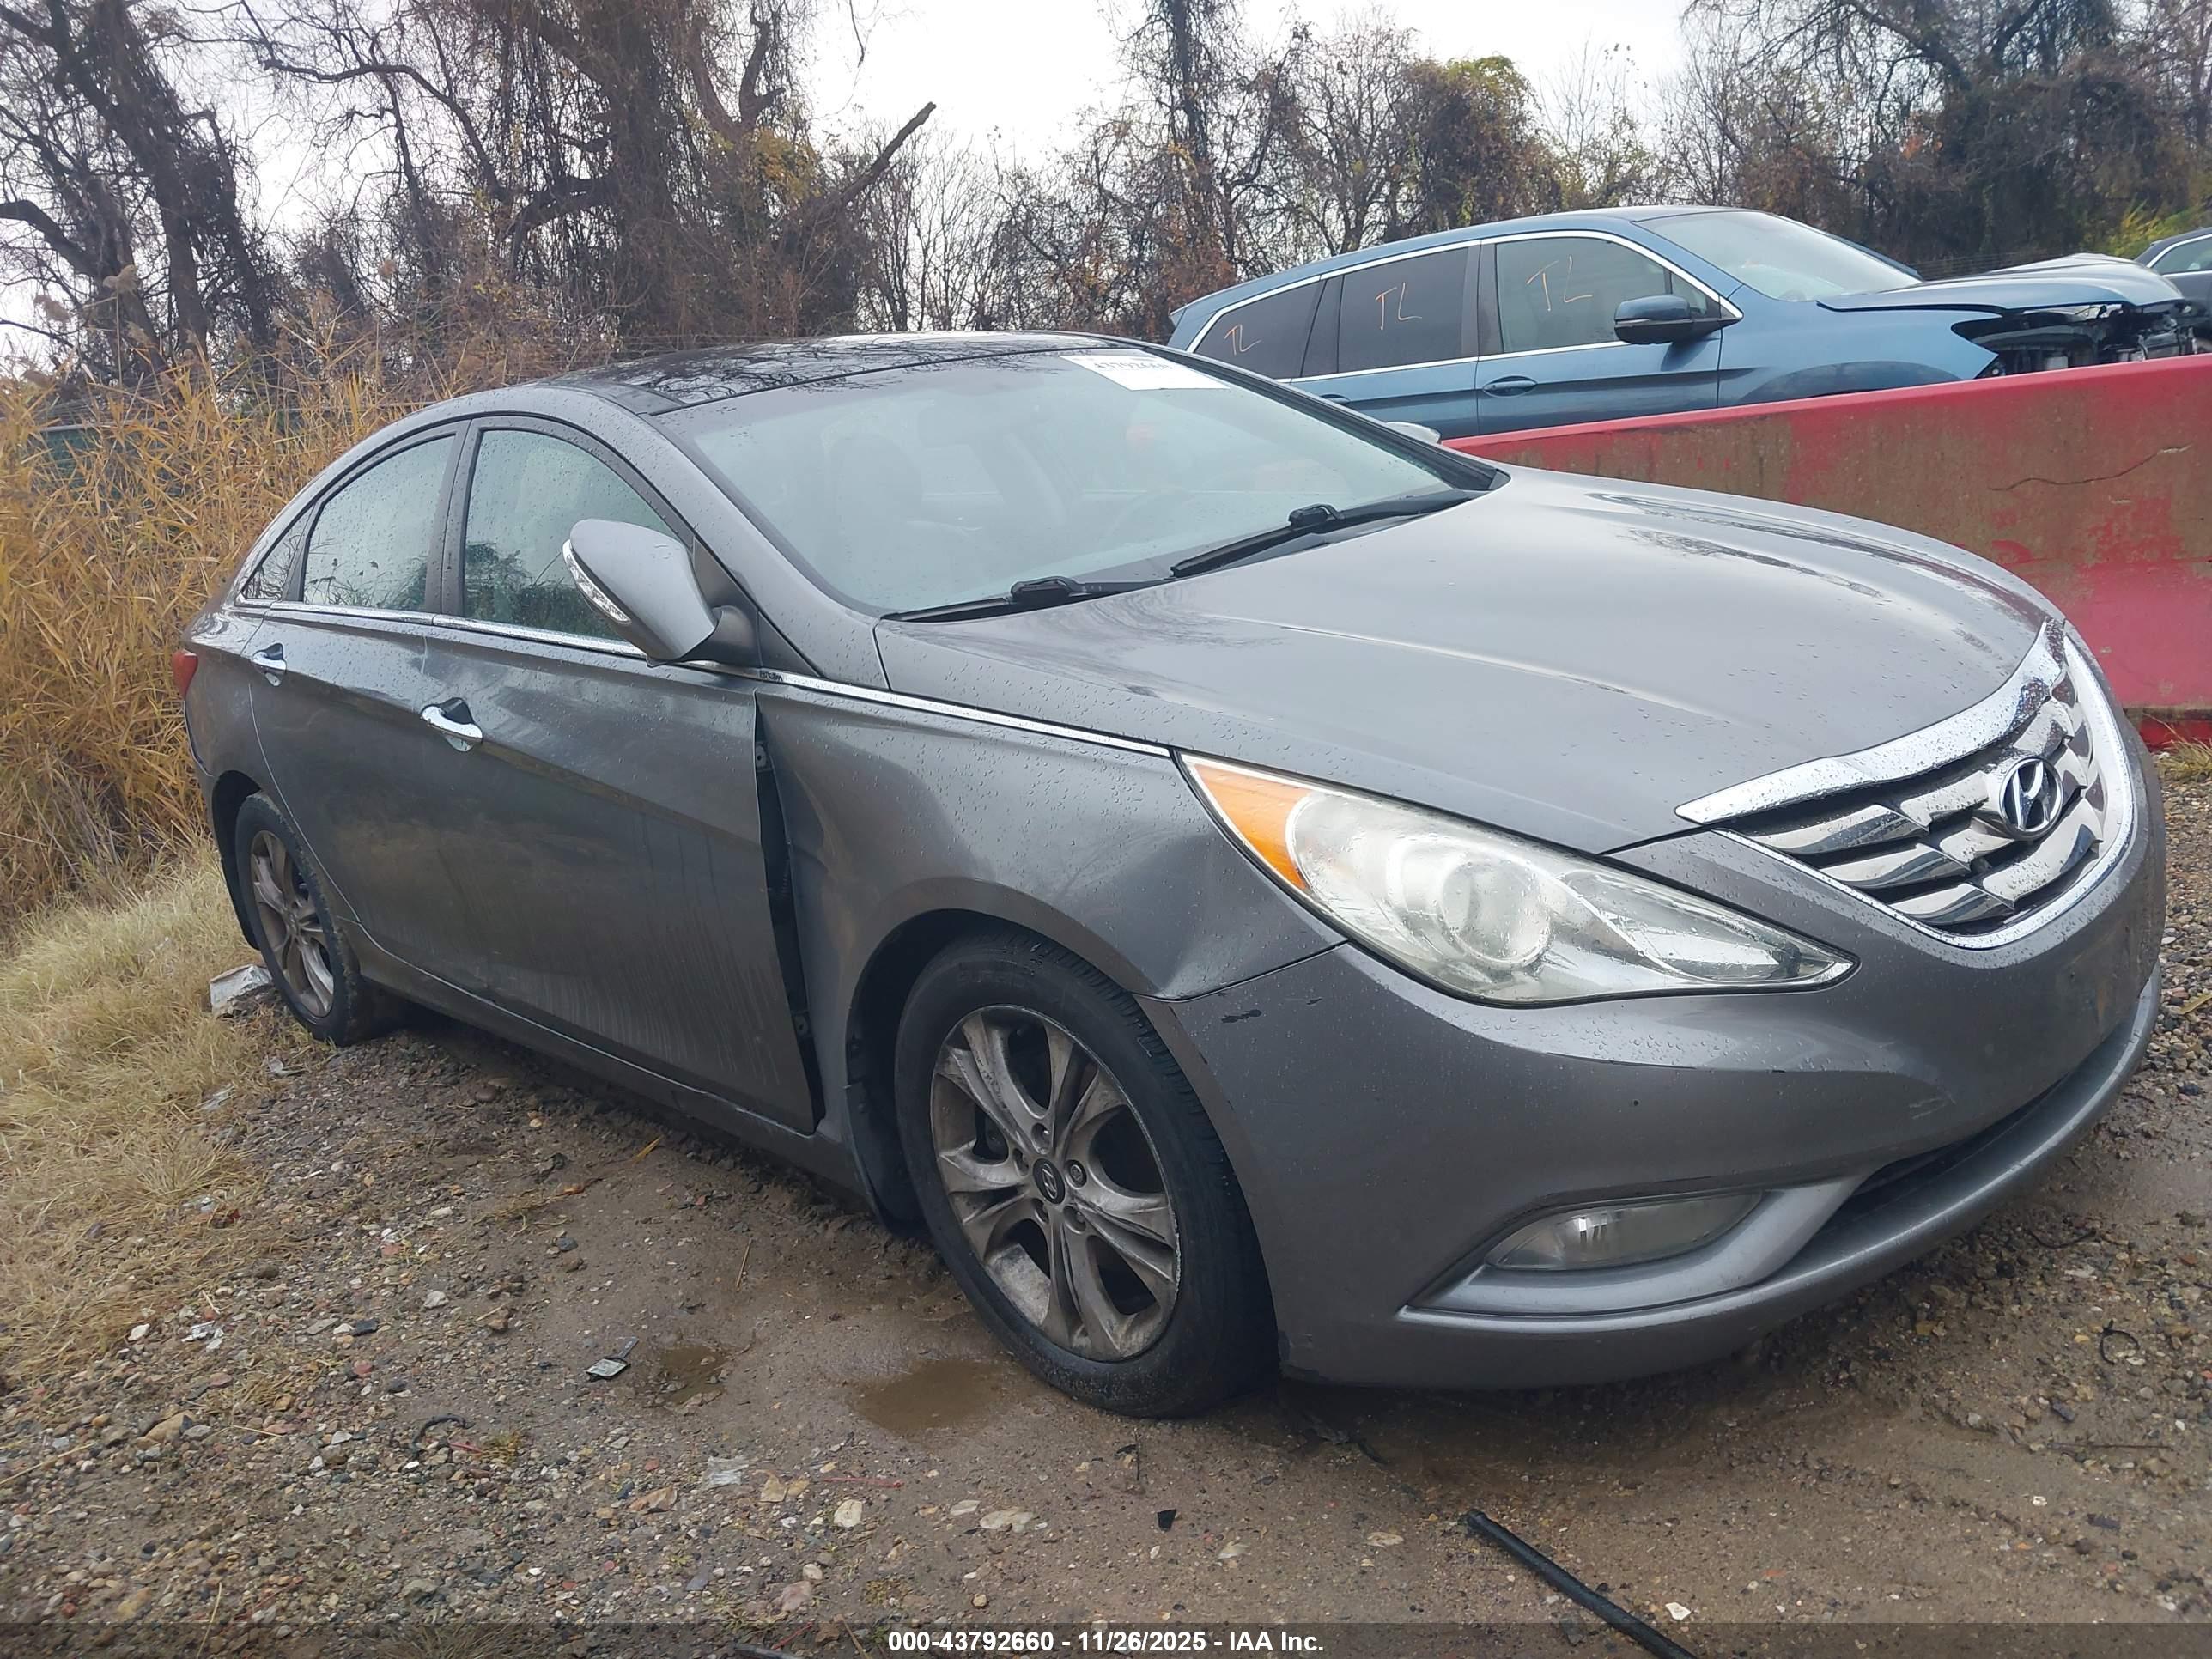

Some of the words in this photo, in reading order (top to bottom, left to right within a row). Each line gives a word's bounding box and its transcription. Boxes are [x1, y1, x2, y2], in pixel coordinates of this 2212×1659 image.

[1376, 282, 1422, 331] TL
[1526, 255, 1593, 312] TL
[1224, 324, 1262, 356] TL
